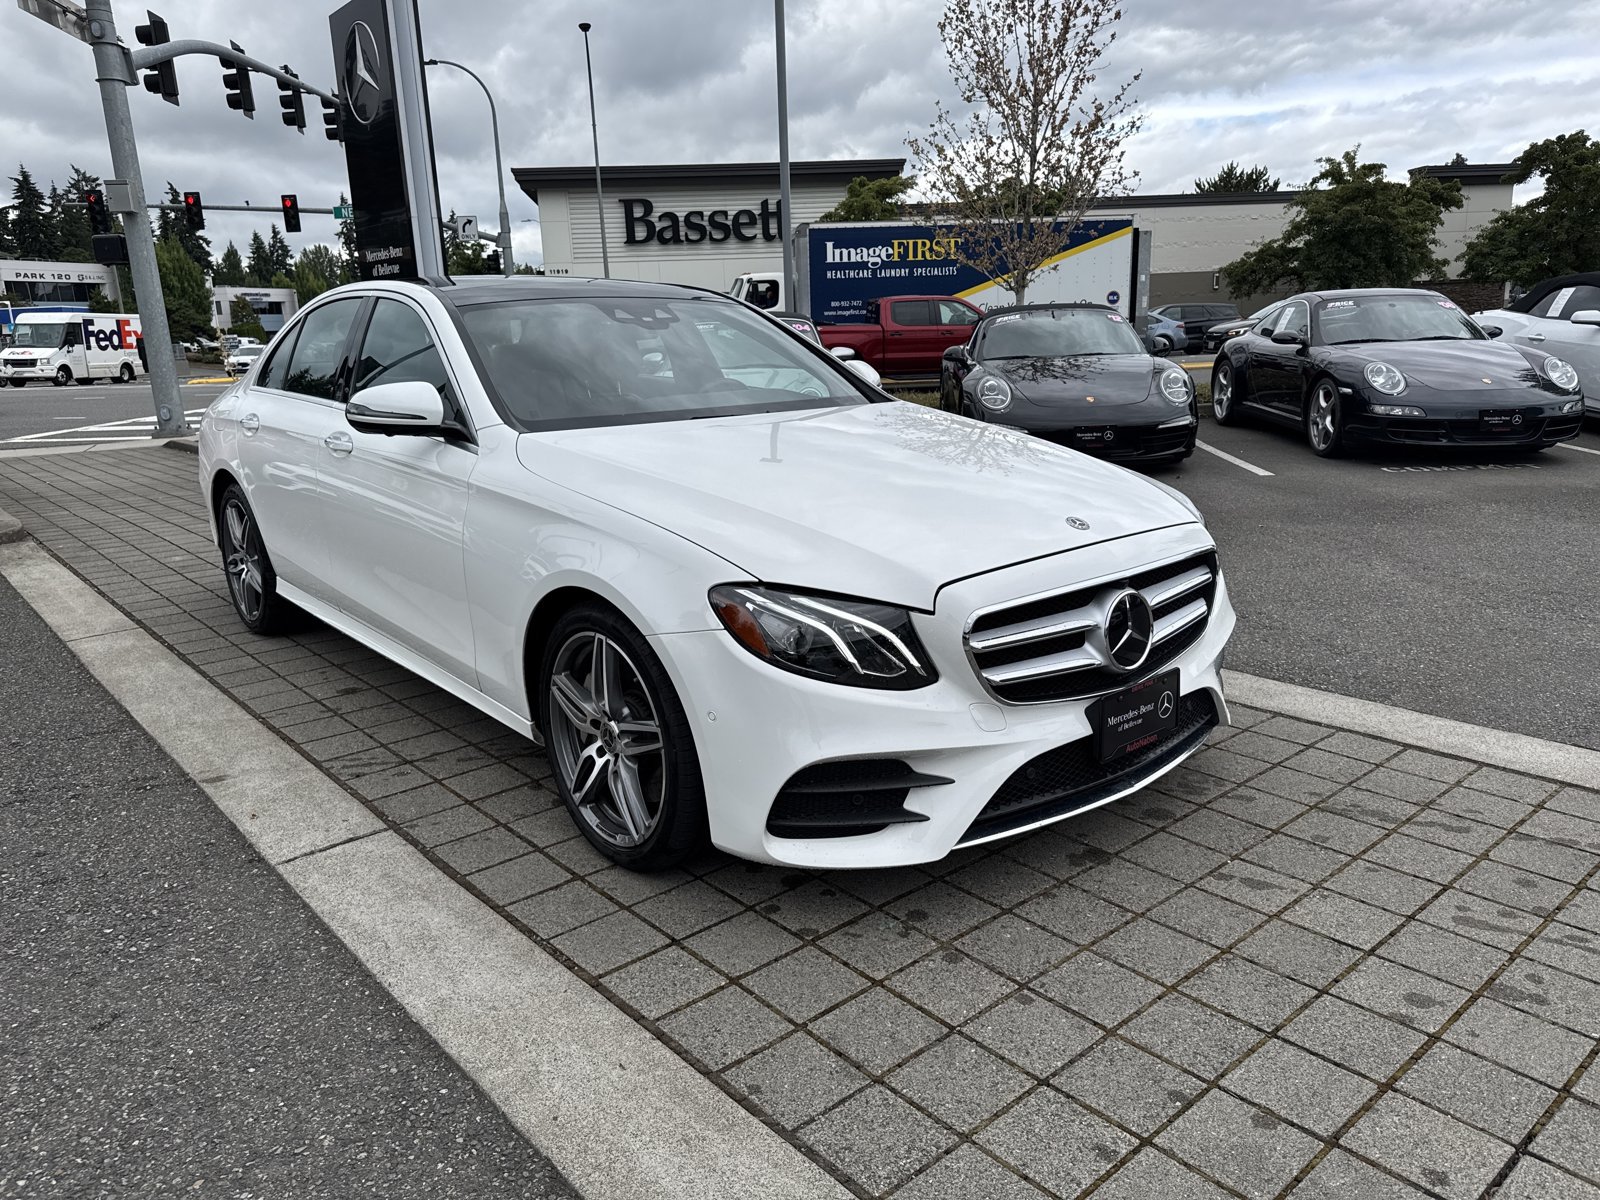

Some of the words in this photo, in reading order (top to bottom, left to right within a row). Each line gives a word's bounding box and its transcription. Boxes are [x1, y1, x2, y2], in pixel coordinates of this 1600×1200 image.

[341, 207, 353, 218] NE
[366, 246, 403, 262] Mercedes-Benz
[825, 238, 961, 268] ImageFIRST
[15, 272, 46, 280] PARK
[51, 273, 71, 281] 120
[373, 264, 378, 277] of
[378, 263, 400, 276] Bellevue
[826, 268, 872, 279] HEALTHCARE
[877, 268, 909, 278] LAUNDRY
[913, 266, 957, 277] SPECIALISTS
[1107, 702, 1155, 727] Mercedes-Benz
[1117, 724, 1123, 732] of
[1123, 718, 1143, 730] Bellevue
[1125, 734, 1159, 753] AutoNation
